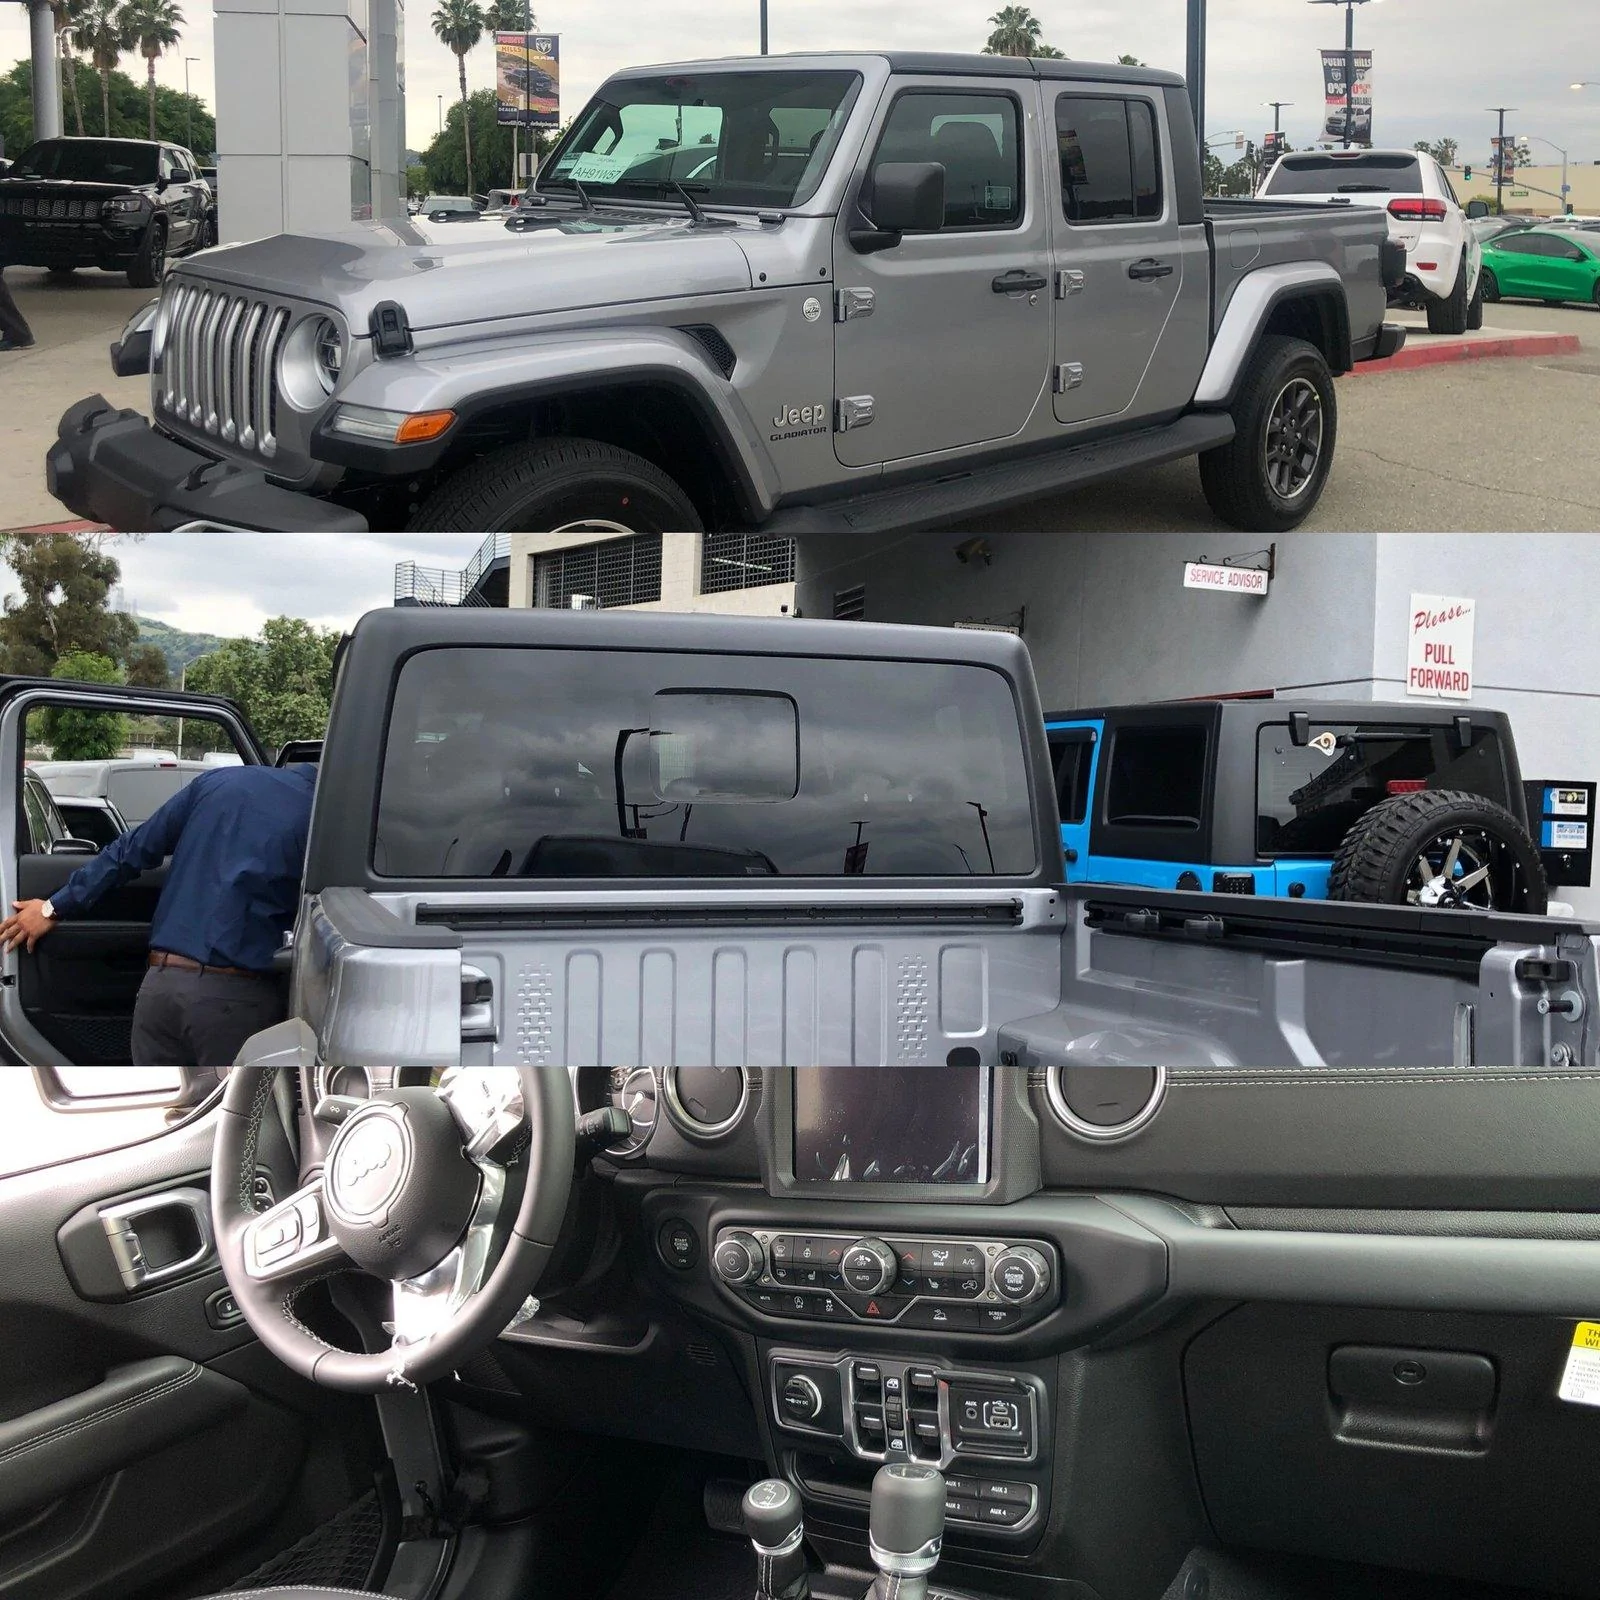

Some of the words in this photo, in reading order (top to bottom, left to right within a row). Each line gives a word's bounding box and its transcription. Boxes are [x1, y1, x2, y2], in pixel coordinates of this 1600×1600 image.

[1323, 58, 1346, 67] PUENT
[573, 167, 622, 180] AH91W57
[772, 404, 826, 428] Jeep
[770, 427, 827, 442] GLADIATOR
[1190, 568, 1225, 585] SERVICE
[1227, 571, 1263, 589] ADVISOR
[1424, 643, 1455, 665] PULL
[1410, 667, 1469, 692] FORWARD
[962, 1258, 975, 1266] A/C
